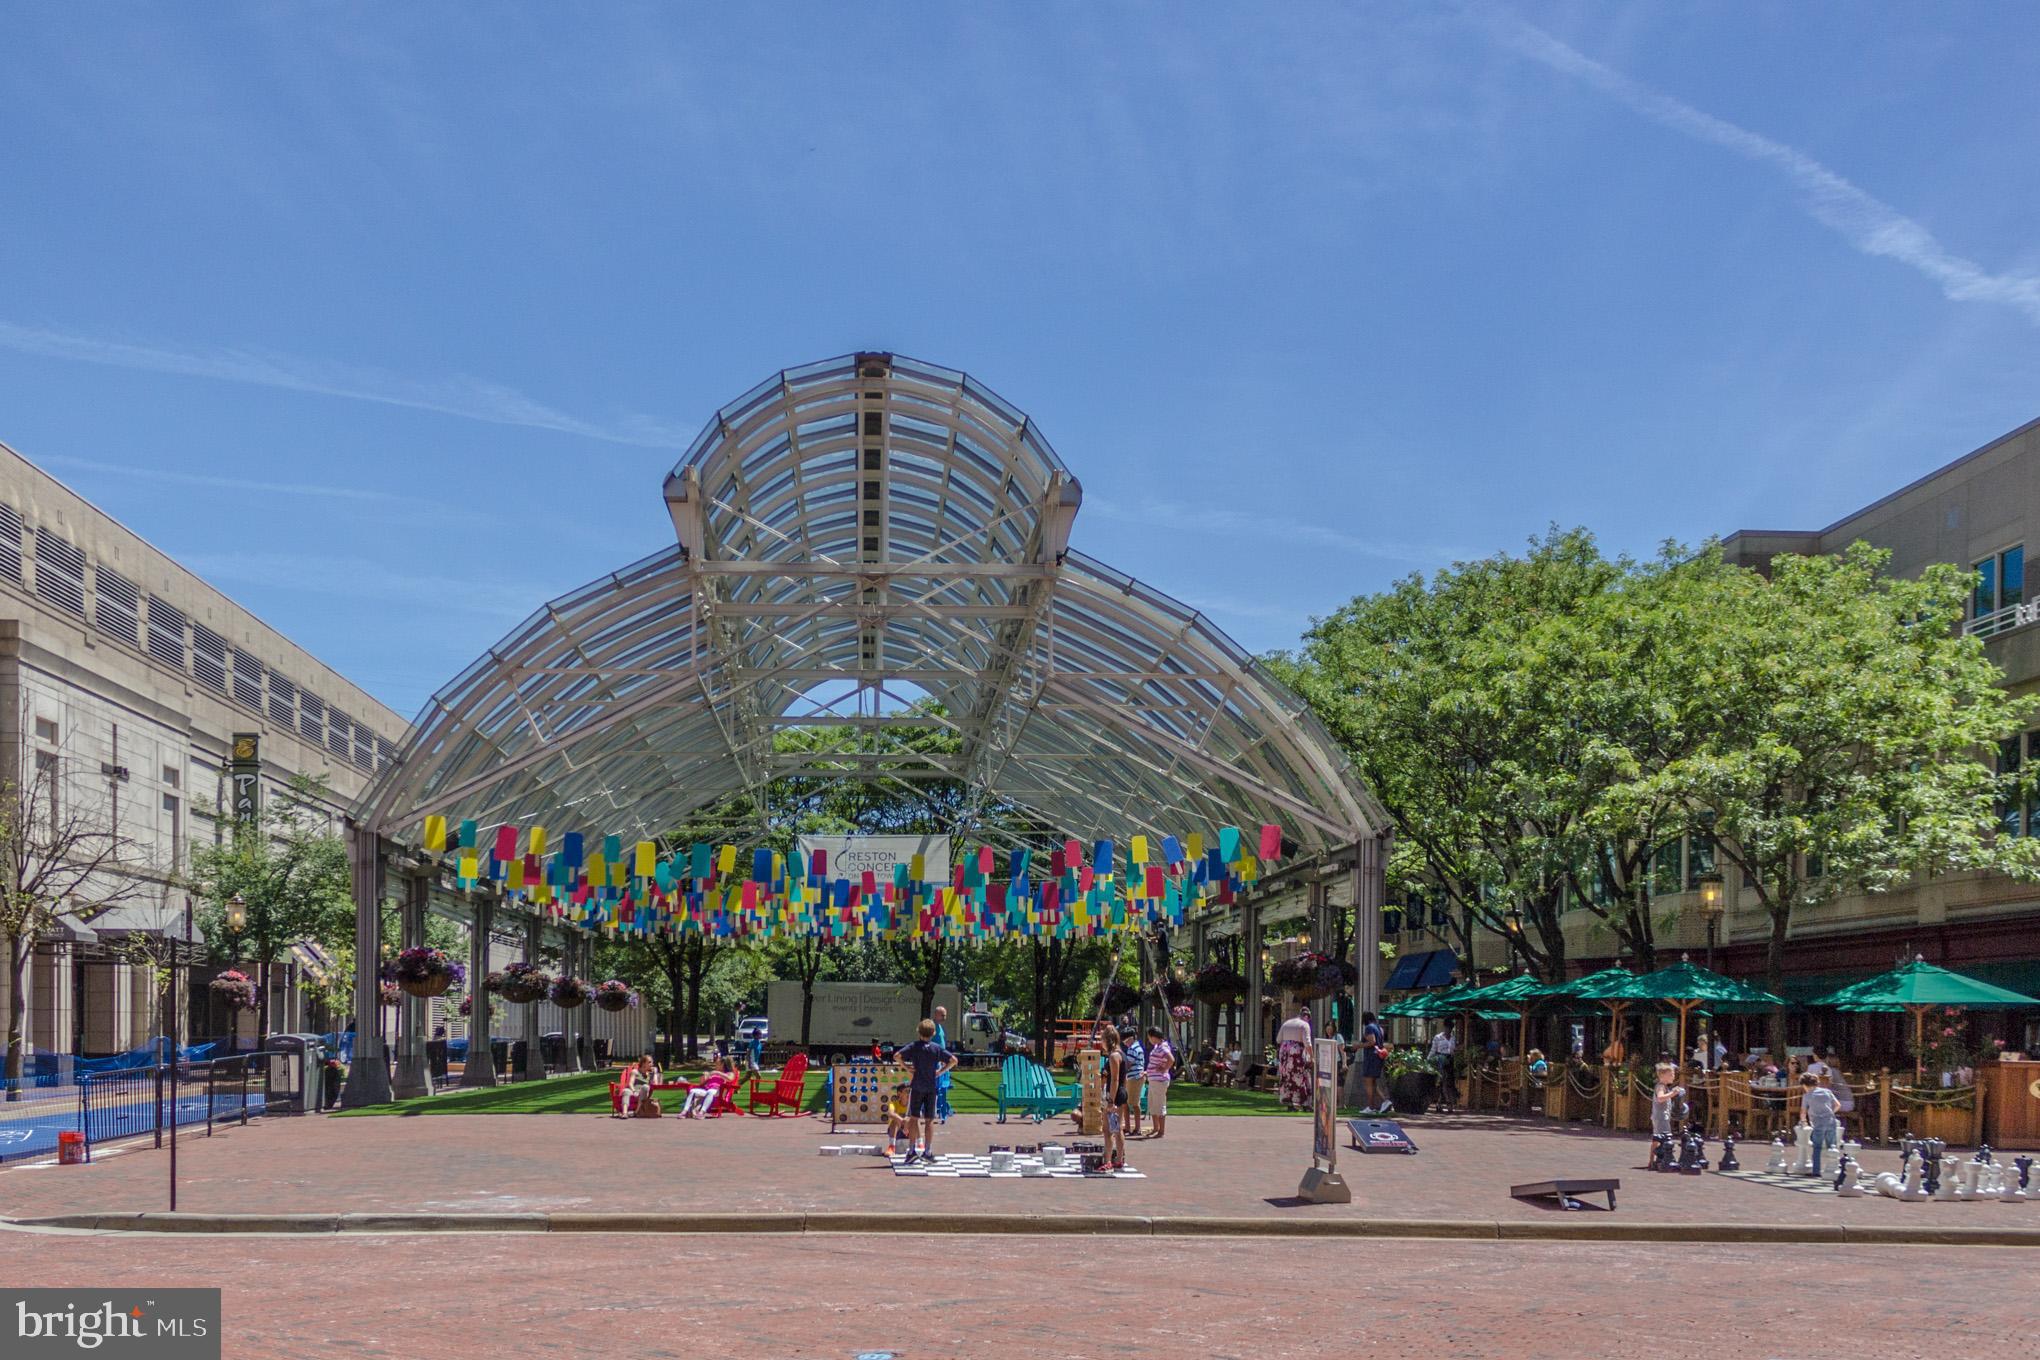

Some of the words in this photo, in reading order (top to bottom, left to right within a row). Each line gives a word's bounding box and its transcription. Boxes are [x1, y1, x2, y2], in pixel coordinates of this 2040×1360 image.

[848, 851, 896, 861] RESTON
[848, 862, 912, 872] CONCES
[800, 993, 826, 1003] Sver
[828, 993, 858, 1005] Lining
[863, 993, 896, 1005] Design
[897, 993, 922, 1003] Grou
